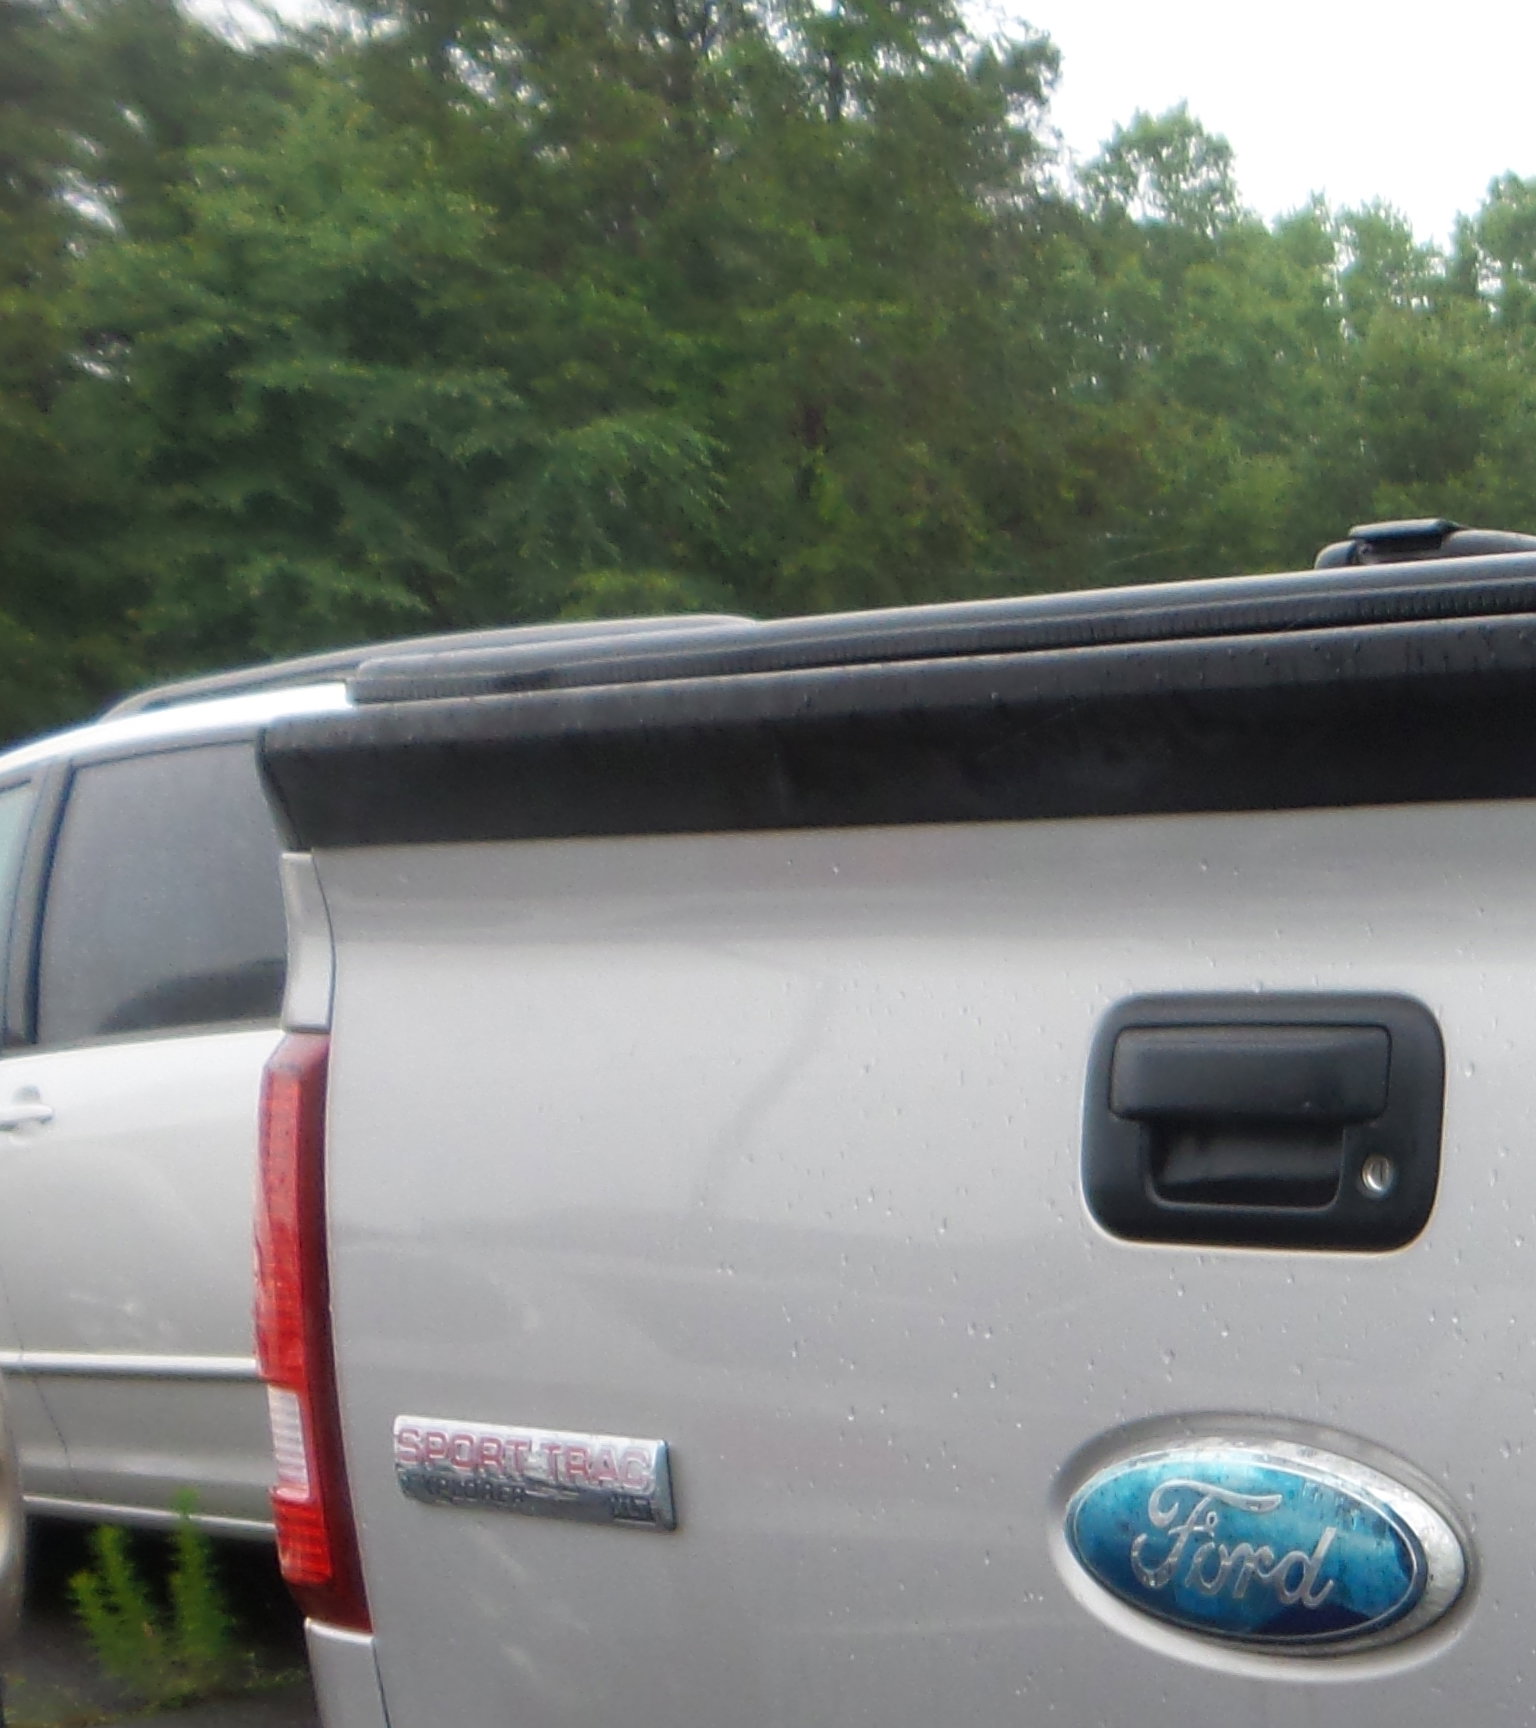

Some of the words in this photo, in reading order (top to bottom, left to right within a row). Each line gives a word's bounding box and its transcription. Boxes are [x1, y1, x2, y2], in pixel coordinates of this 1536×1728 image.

[397, 1428, 533, 1476] SPORT
[540, 1441, 652, 1490] TRAC
[1130, 1477, 1338, 1610] Ford
